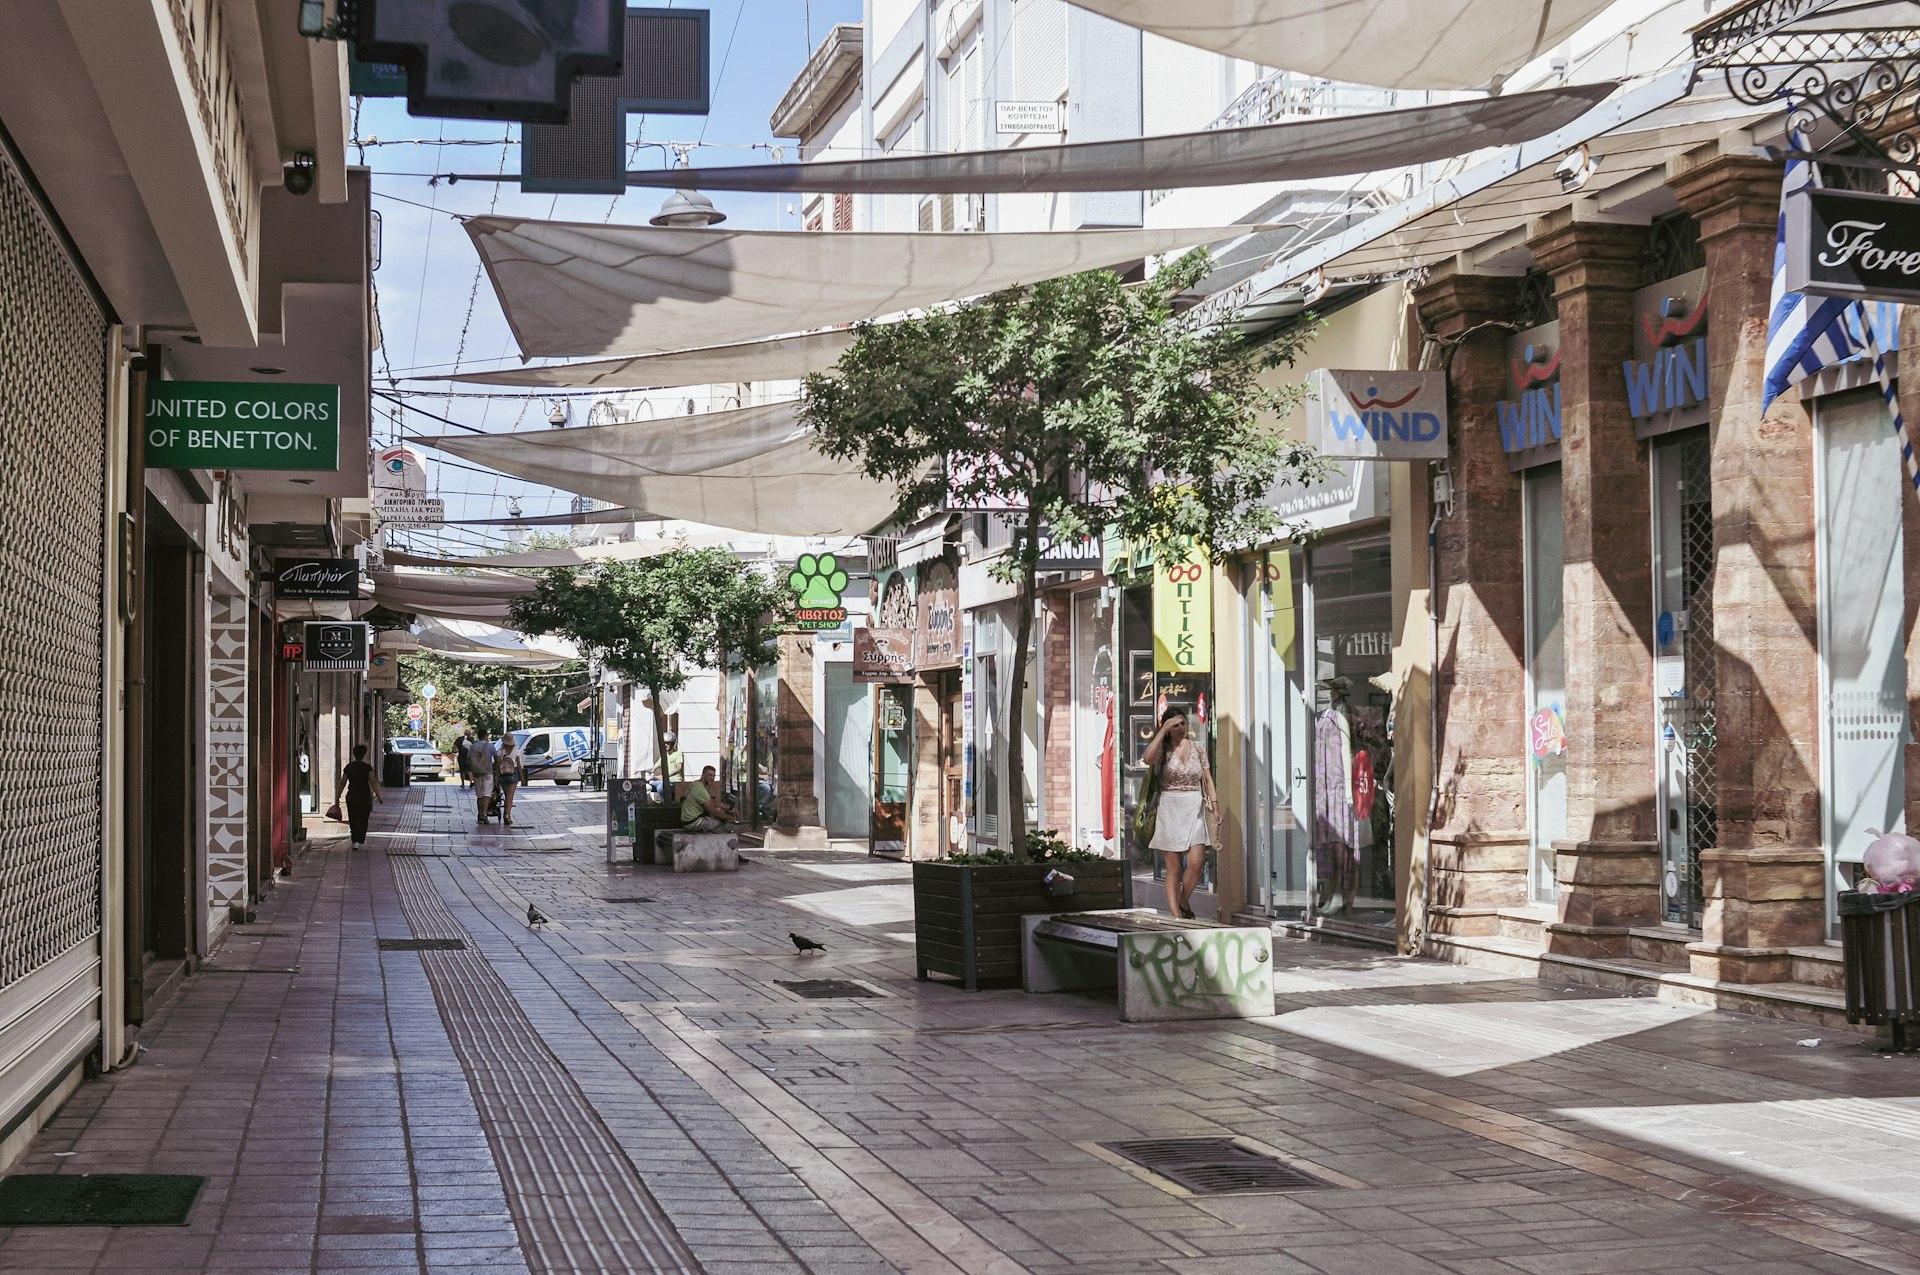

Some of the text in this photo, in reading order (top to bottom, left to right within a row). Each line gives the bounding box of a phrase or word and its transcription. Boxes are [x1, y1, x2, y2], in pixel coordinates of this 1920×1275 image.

[1622, 337, 1707, 418] WIN
[234, 400, 329, 421] COLORS
[1496, 382, 1562, 453] WIN
[149, 428, 318, 451] OF BENETTON.
[1328, 410, 1441, 442] WIND
[818, 621, 840, 629] SHOP
